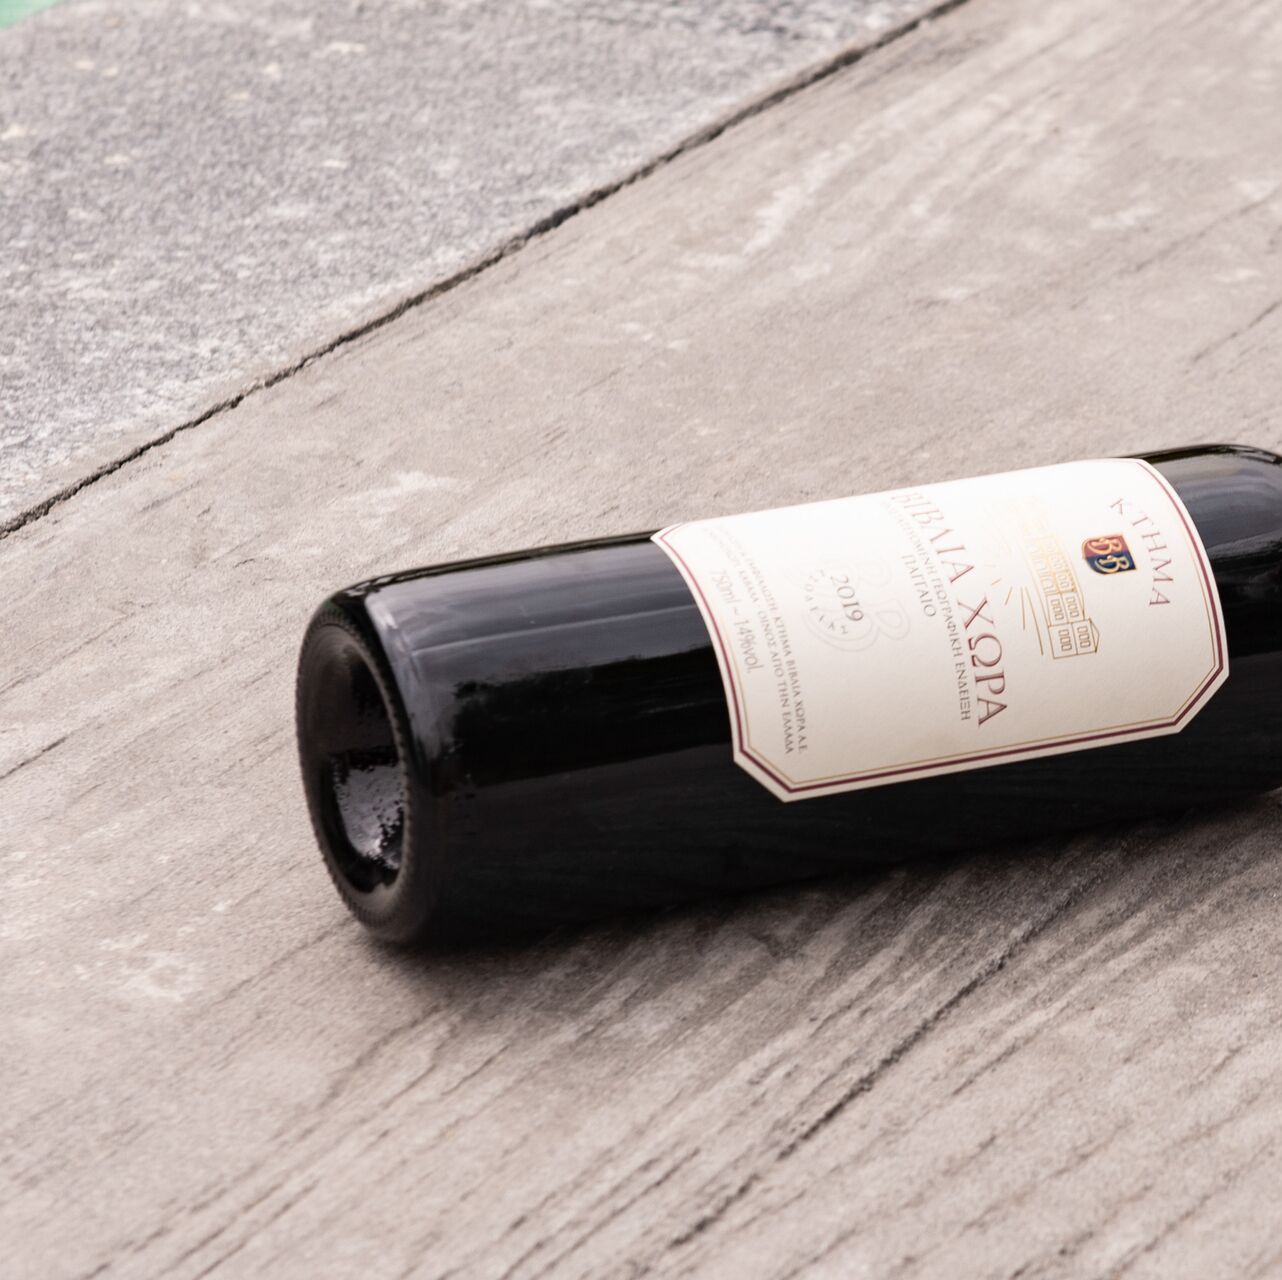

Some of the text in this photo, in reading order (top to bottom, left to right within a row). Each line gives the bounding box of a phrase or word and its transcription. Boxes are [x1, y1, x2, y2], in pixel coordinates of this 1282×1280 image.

[830, 574, 865, 622] 2019
[900, 552, 937, 618] ΠΑΓΓΑΙΟ
[1108, 497, 1174, 607] ΚΤΗΜΑ
[930, 577, 963, 658] ΓΕΩΓΡΑΦΙΚΗ
[953, 661, 972, 721] ΕΝΔΕΙΞΗ
[956, 593, 1008, 727] ΧΩΡΑ
